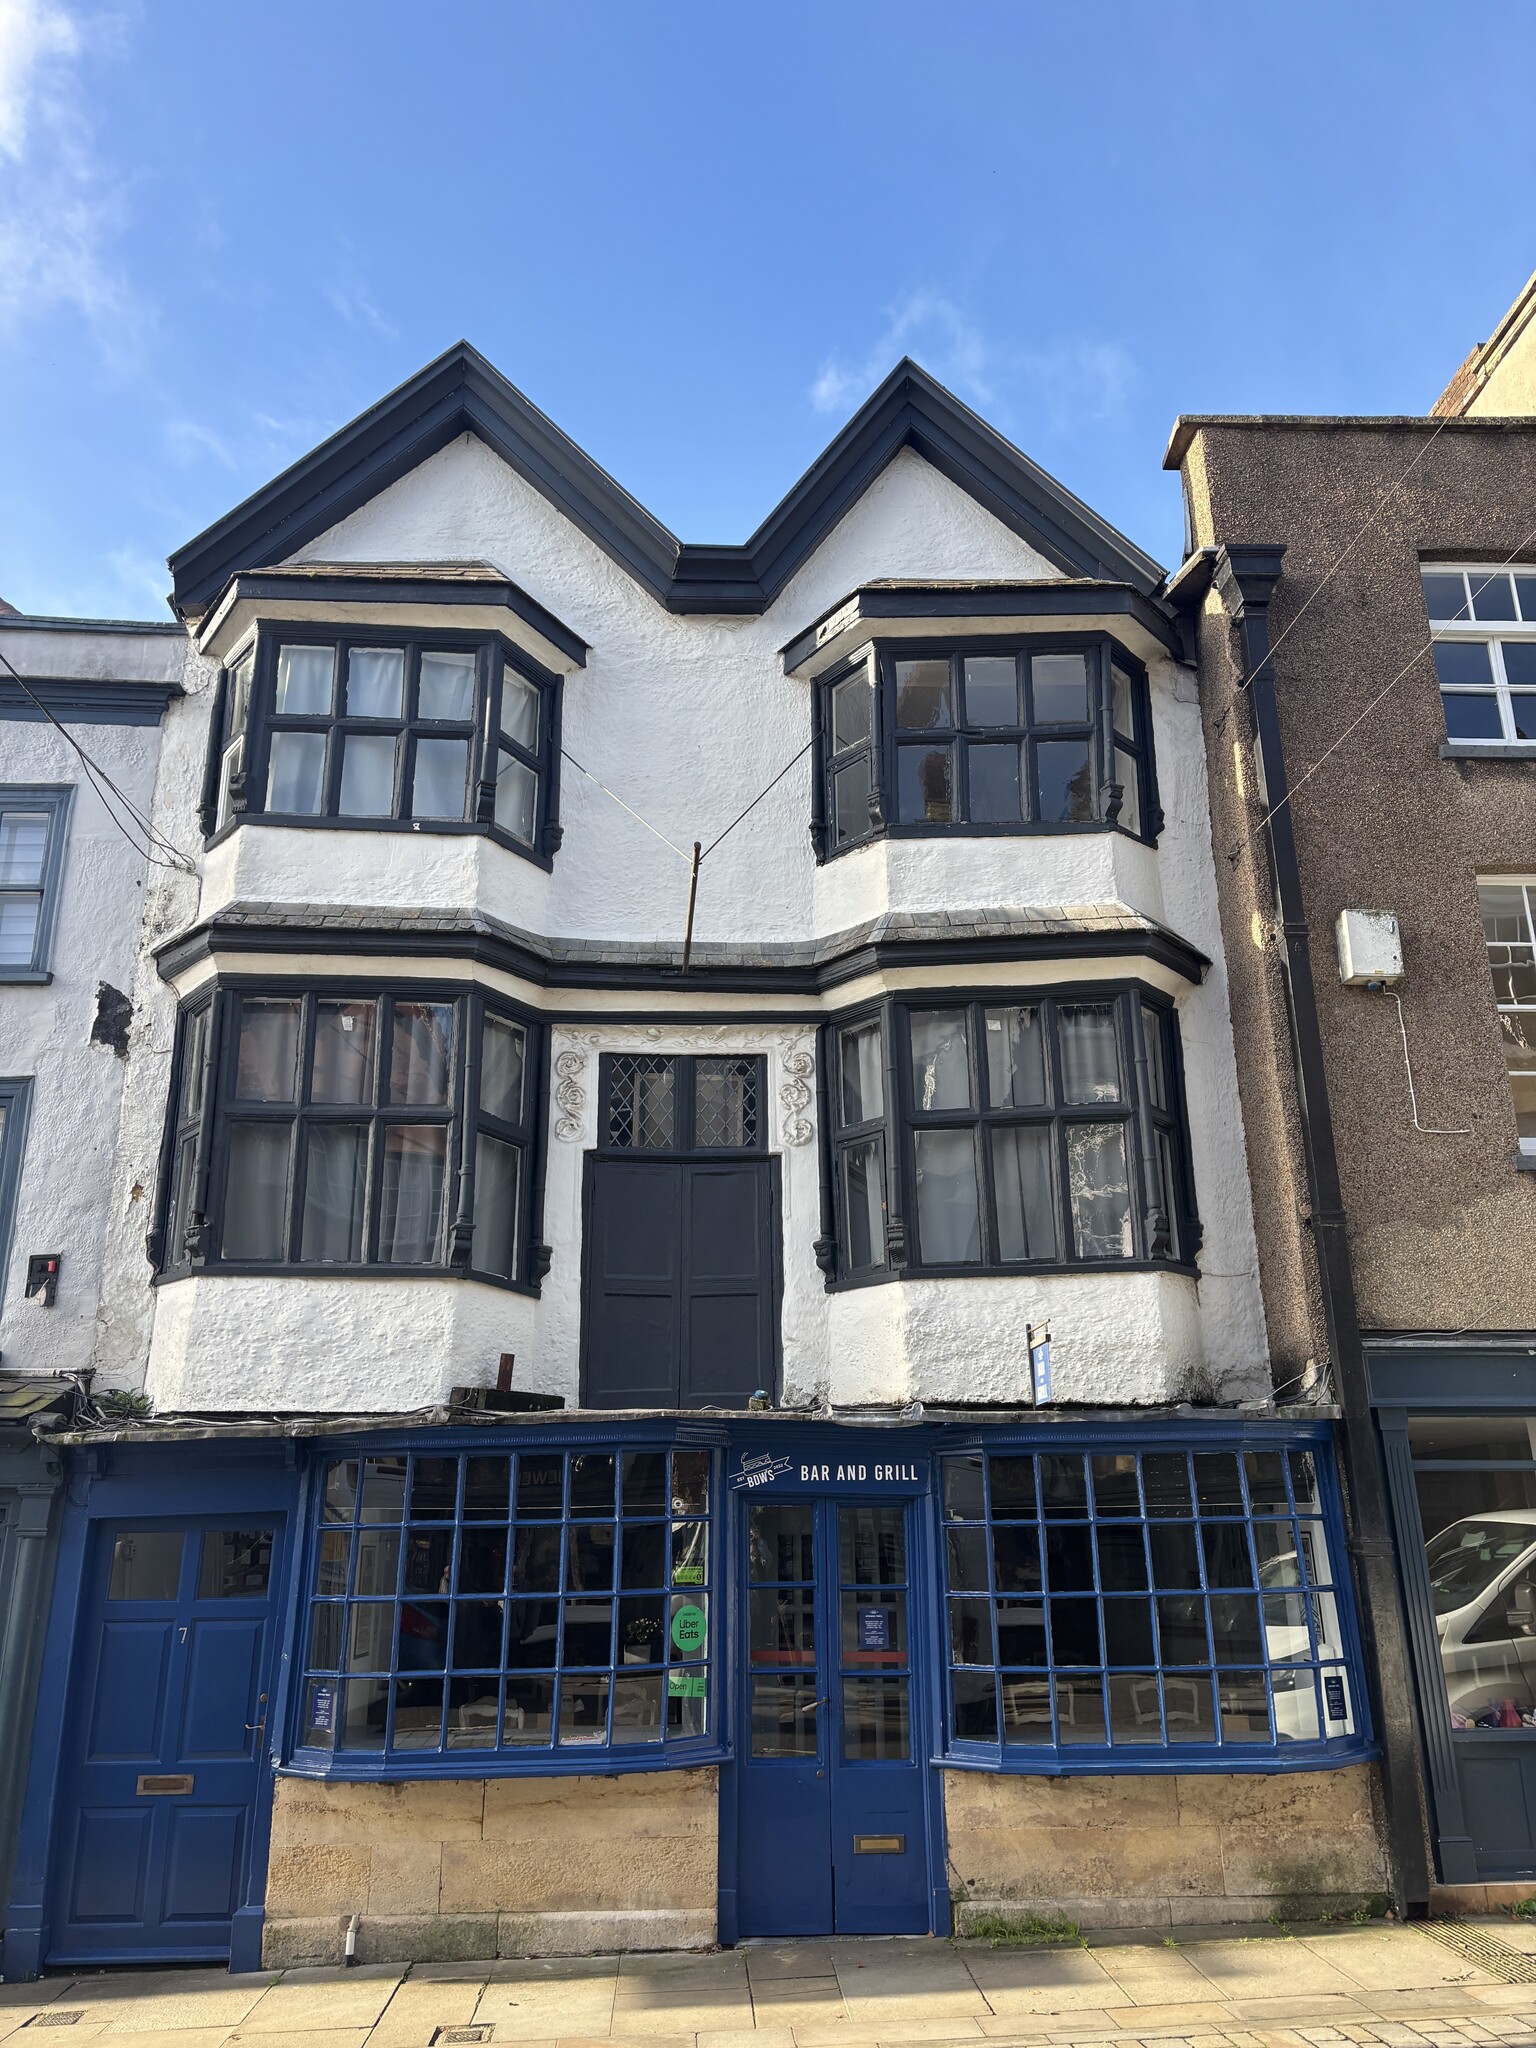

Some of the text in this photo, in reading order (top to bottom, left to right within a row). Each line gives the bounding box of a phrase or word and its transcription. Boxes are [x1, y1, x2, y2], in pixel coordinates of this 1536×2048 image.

[801, 1464, 918, 1481] BAR AND GRILL
[679, 1620, 699, 1629] Uber
[178, 1627, 188, 1644] 7
[679, 1630, 699, 1639] Eats
[670, 1682, 687, 1691] Open
